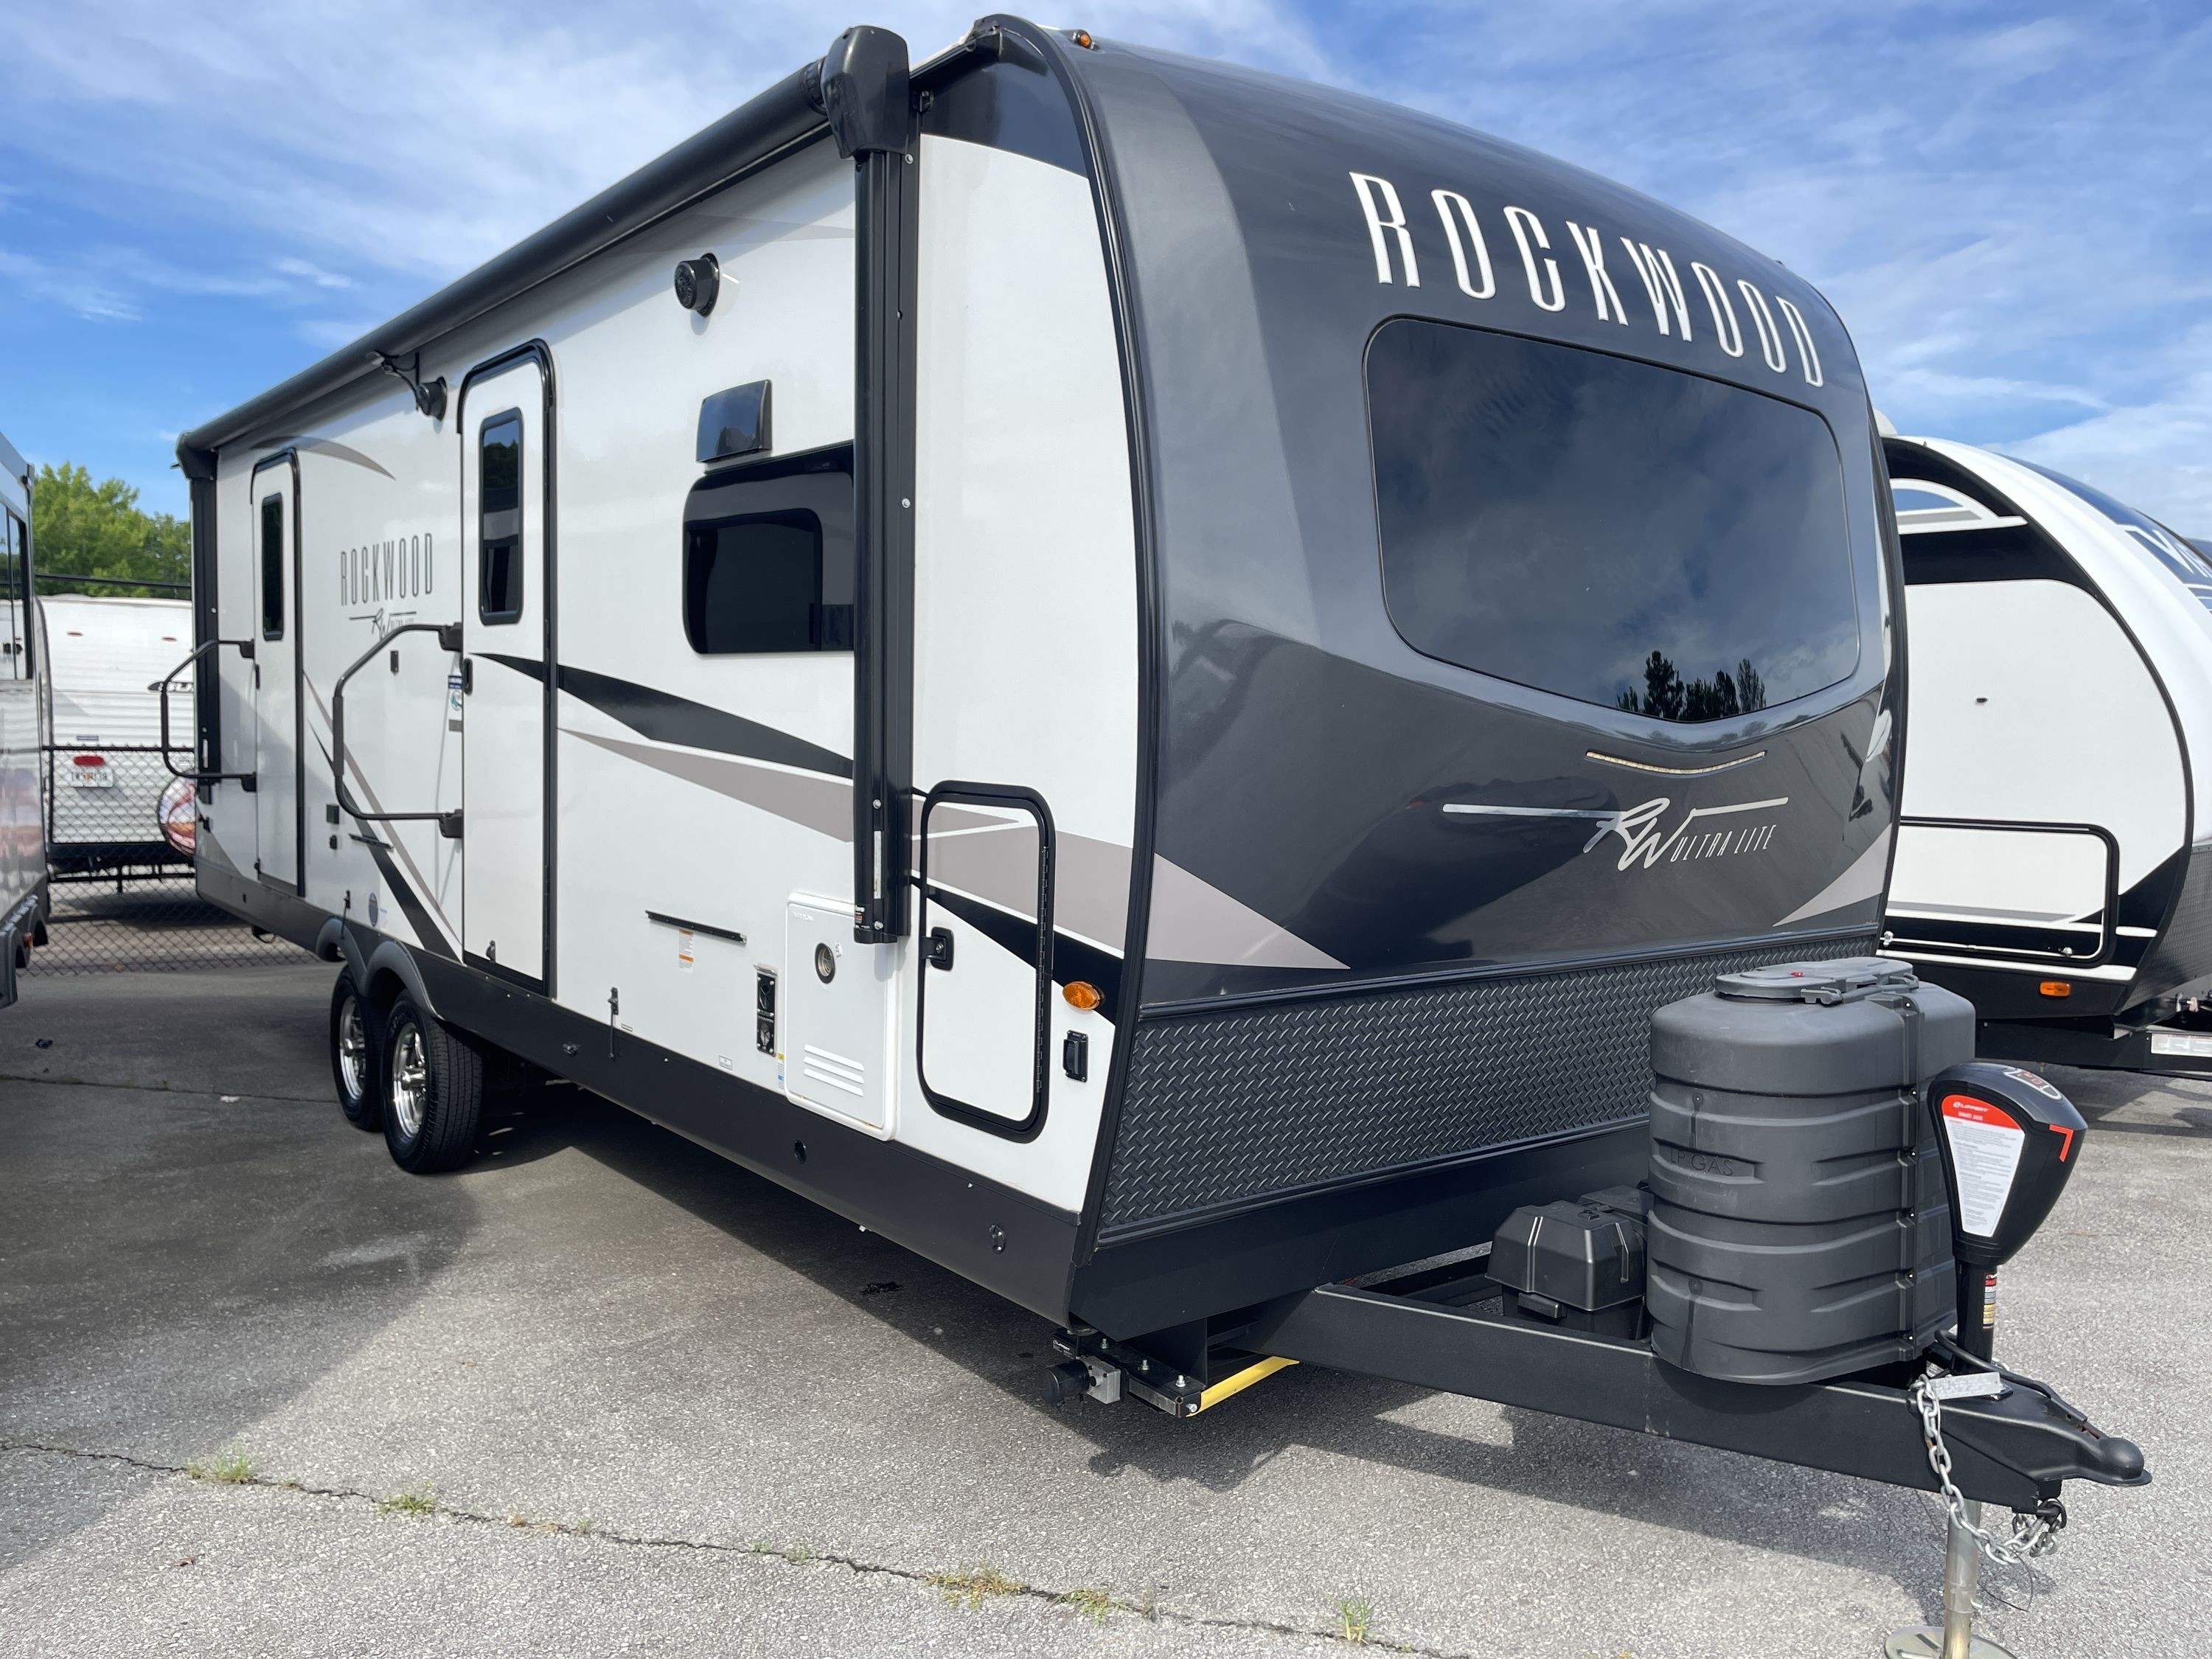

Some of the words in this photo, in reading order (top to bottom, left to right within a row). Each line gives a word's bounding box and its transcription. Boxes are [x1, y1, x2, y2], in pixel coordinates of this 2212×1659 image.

[1349, 170, 1824, 389] ROCKWOOD
[340, 533, 432, 606] ROCKWOOD
[1669, 830, 1733, 863] ULTRA
[1733, 824, 1777, 855] LITE
[1670, 1150, 1686, 1165] LP
[1691, 1153, 1734, 1177] GAS
